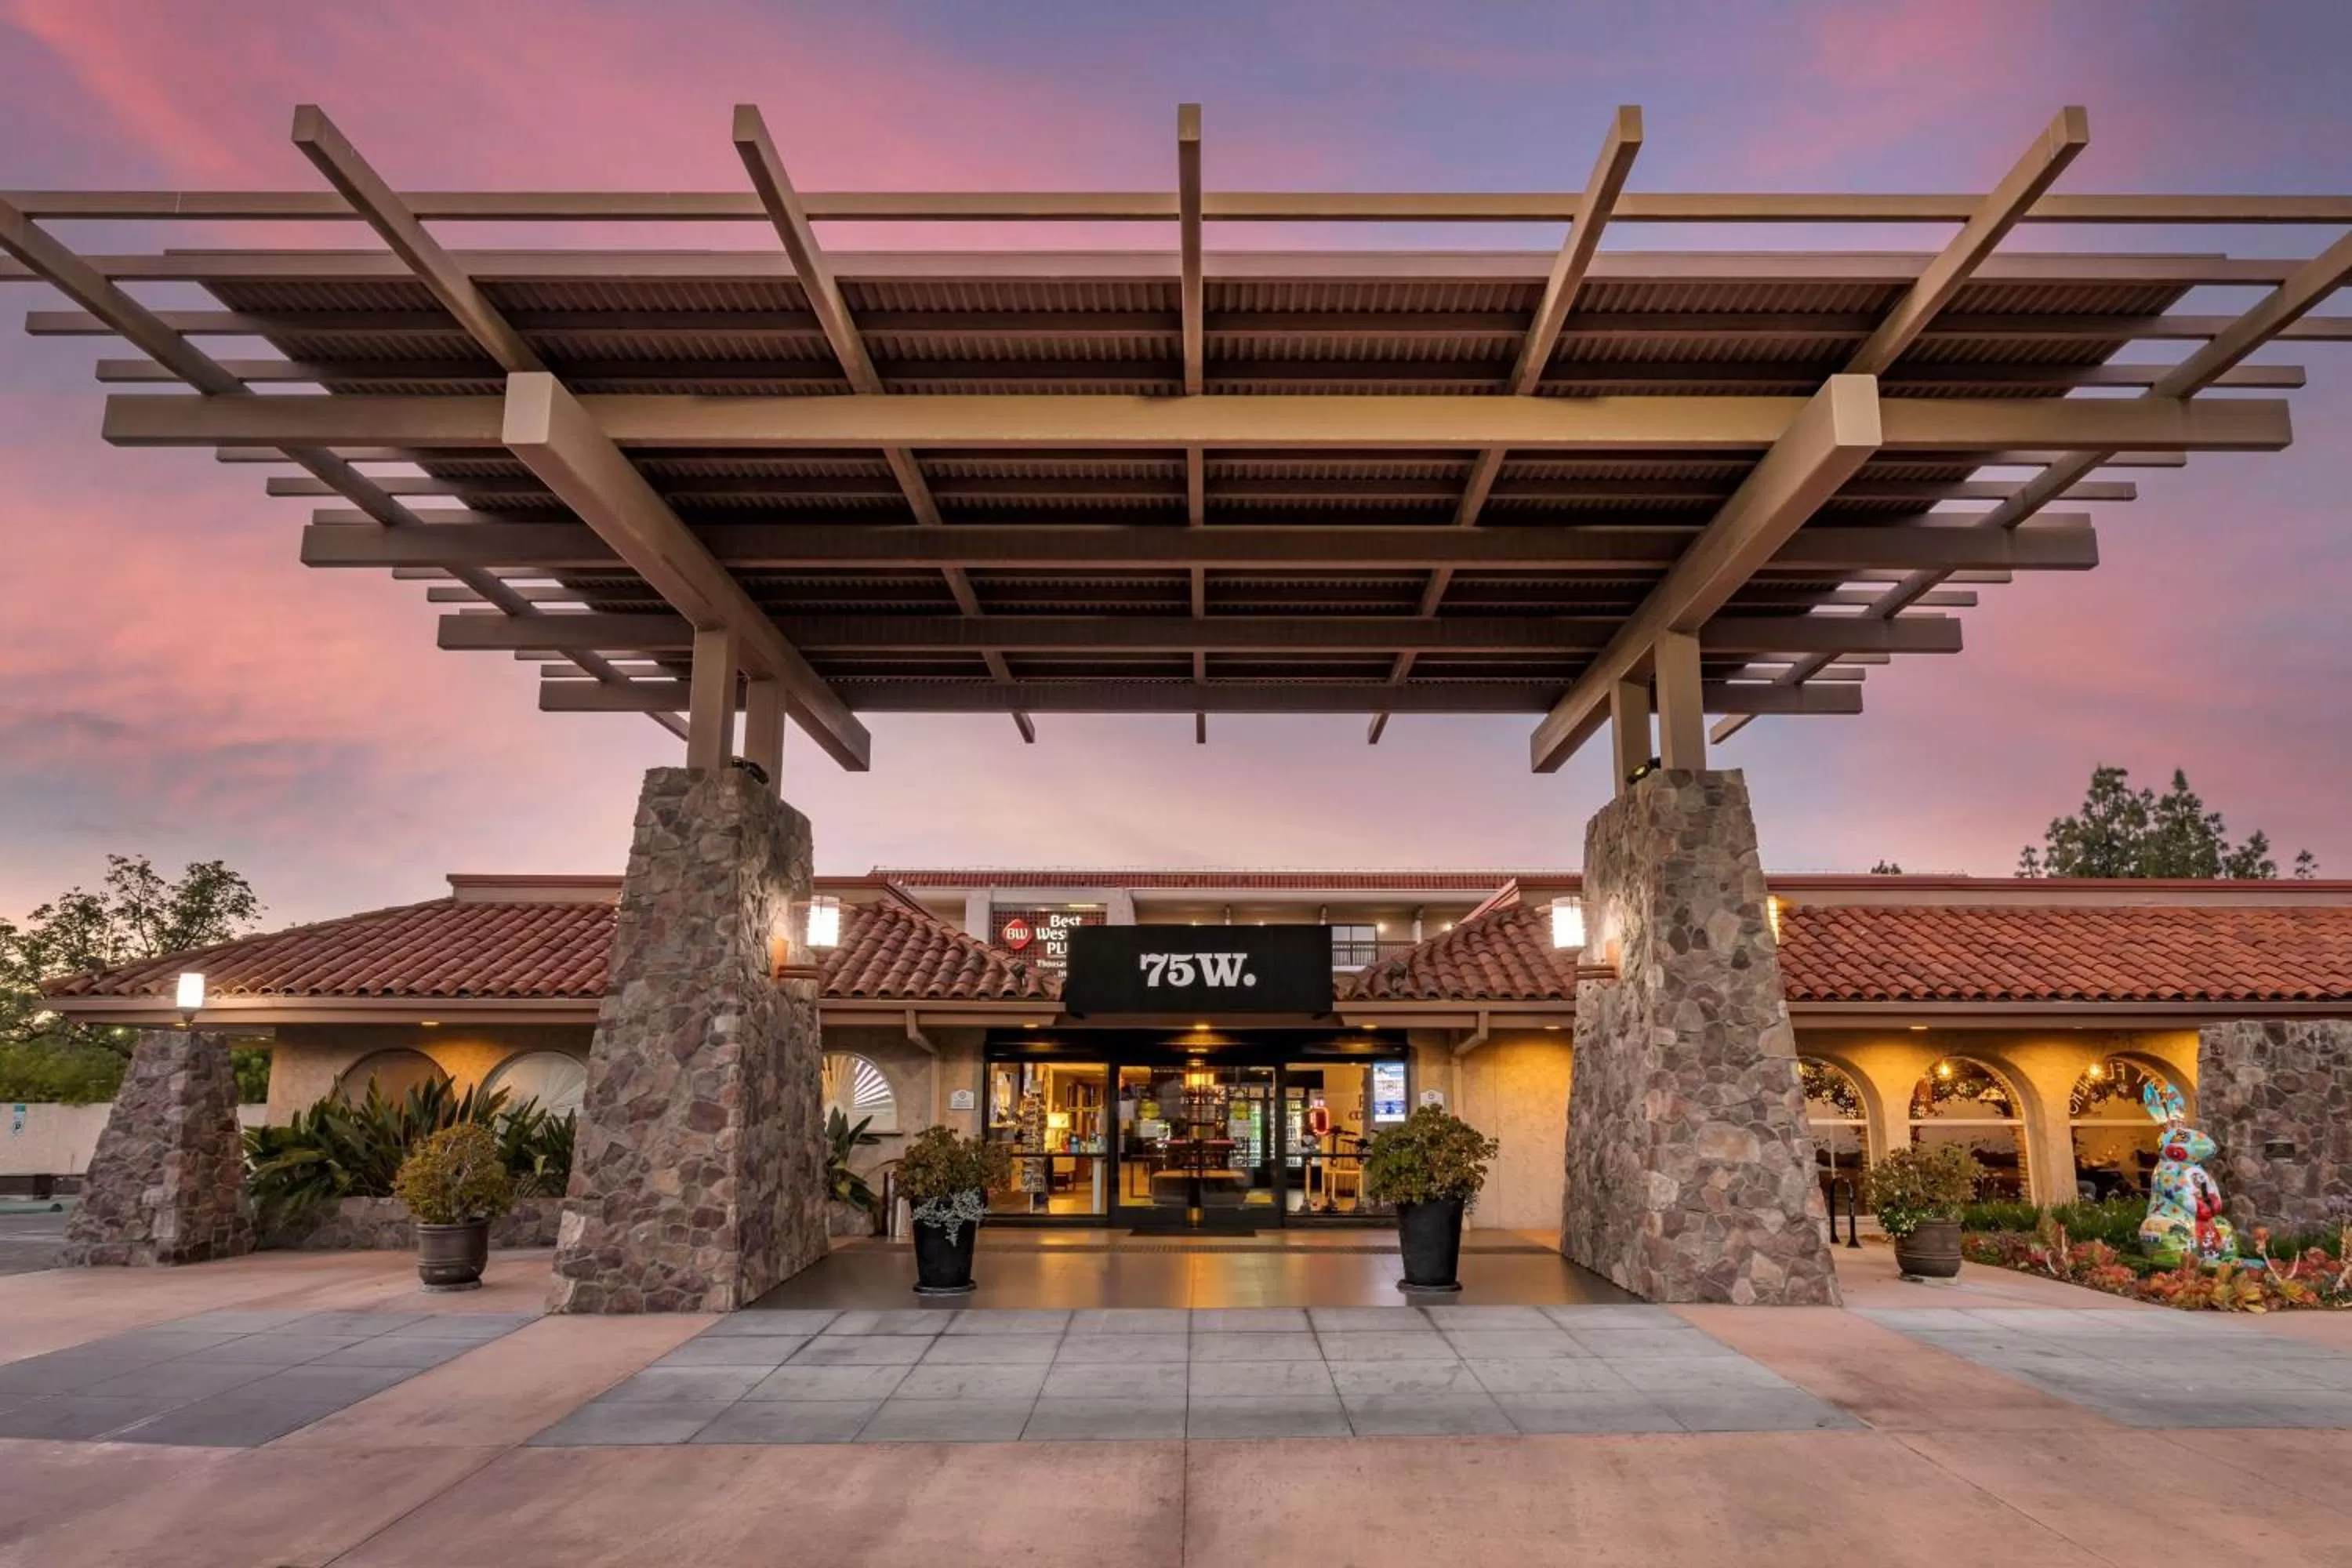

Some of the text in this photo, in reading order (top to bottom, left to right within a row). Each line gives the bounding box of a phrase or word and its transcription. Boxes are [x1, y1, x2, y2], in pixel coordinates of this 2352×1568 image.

[1051, 915, 1081, 927] Best
[1007, 927, 1028, 939] BW
[1140, 953, 1257, 987] 75W.
